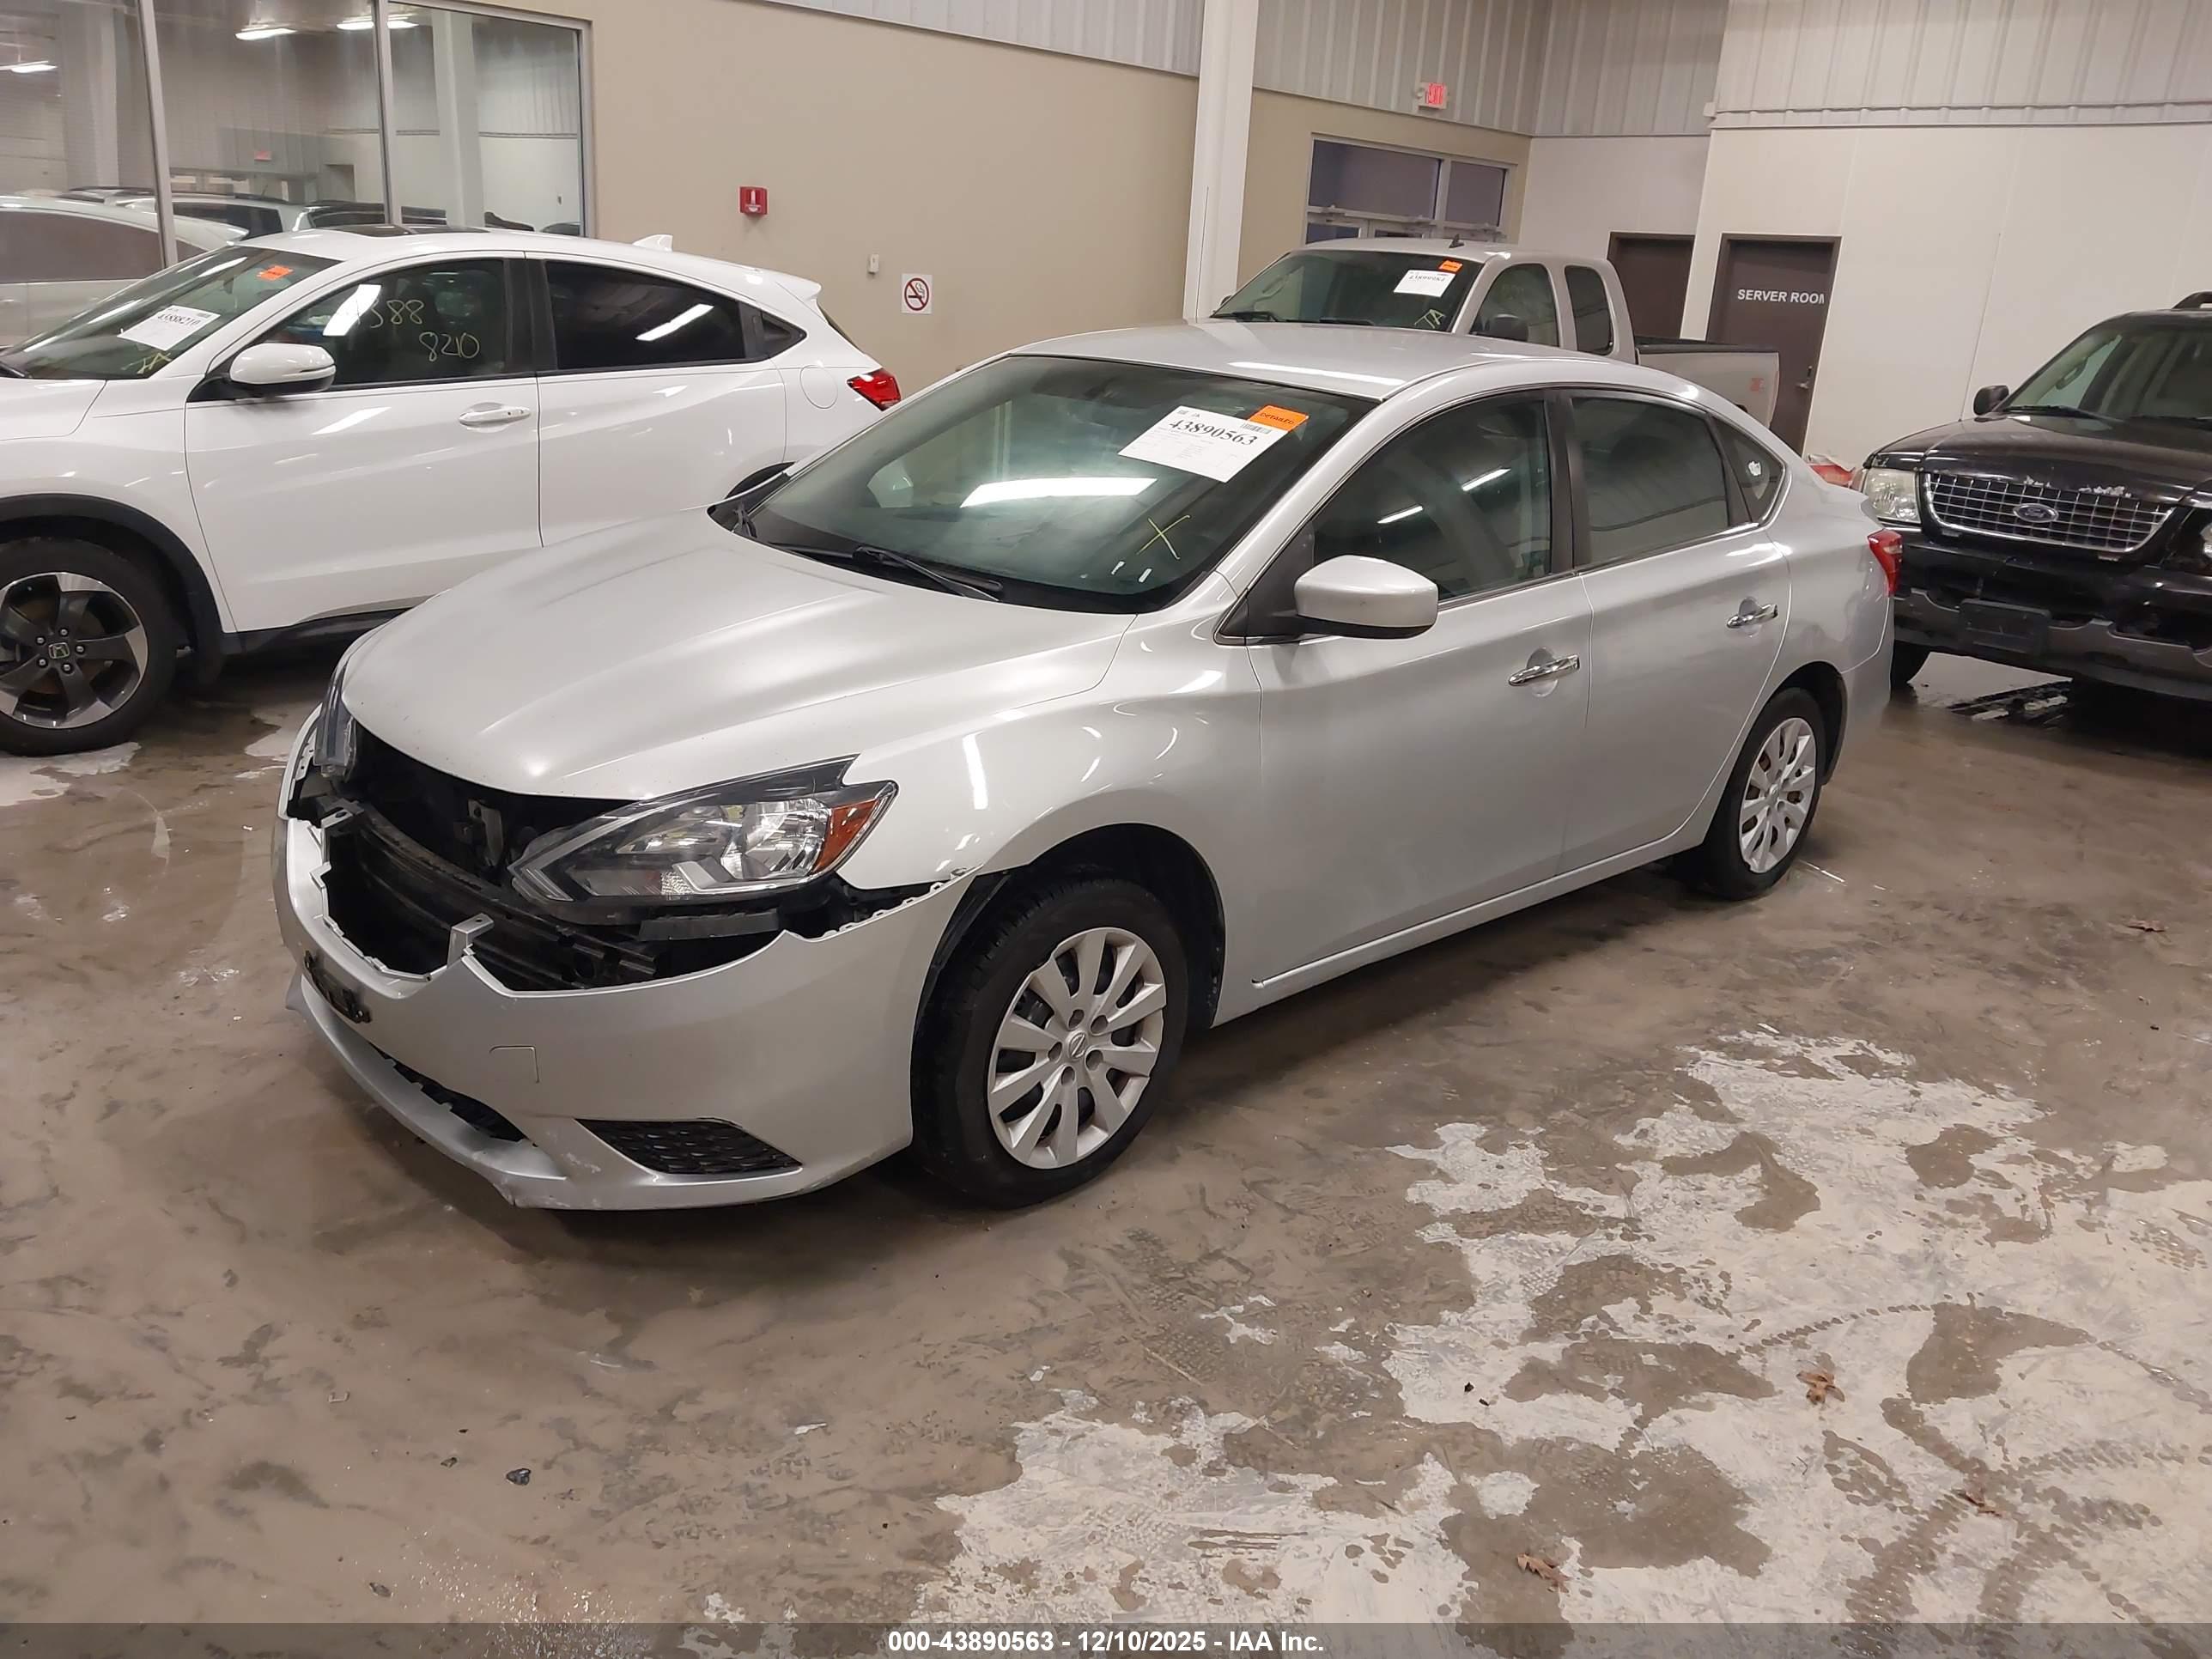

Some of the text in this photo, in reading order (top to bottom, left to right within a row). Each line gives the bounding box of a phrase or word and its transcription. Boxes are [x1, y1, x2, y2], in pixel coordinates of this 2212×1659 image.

[1737, 289, 1787, 303] SERVER
[419, 331, 480, 362] 8210
[1169, 419, 1258, 446] 43890563
